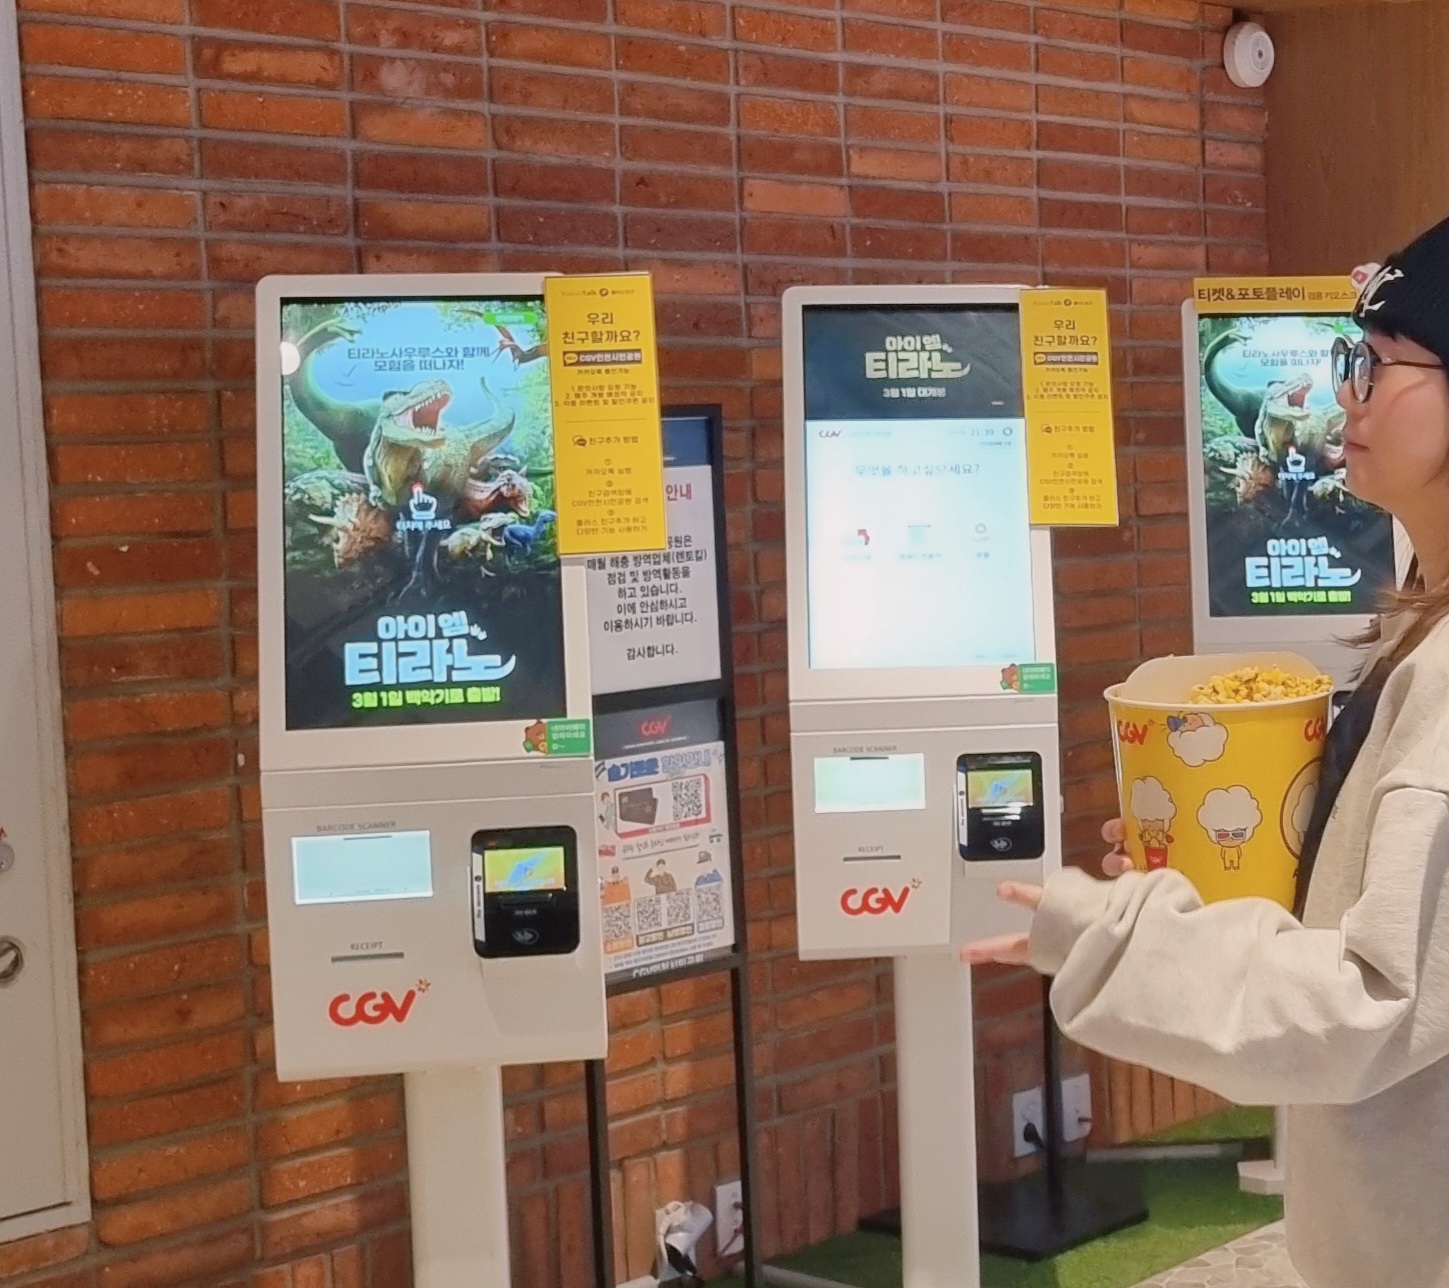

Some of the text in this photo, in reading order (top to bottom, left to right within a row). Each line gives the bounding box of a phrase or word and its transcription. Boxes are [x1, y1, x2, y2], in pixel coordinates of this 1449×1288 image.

[1198, 286, 1306, 303] 티켓&포토플레이
[586, 312, 614, 326] 우리
[1053, 319, 1077, 331] 우리
[562, 329, 641, 345] 친구할까요?
[885, 334, 921, 351] 아이
[1033, 334, 1098, 347] 친구할까요?
[347, 345, 491, 360] 티라노사우루스와 함께
[373, 358, 465, 372] 모험을 떠나자!
[865, 350, 972, 379] 티라노
[666, 484, 693, 501] 안내
[1266, 538, 1306, 556] 아이
[586, 558, 607, 571] 매월
[1245, 555, 1362, 588] 티라노
[607, 566, 691, 586] 점검 및 방역활동을
[617, 582, 683, 599] 하고 있습니다.
[616, 597, 688, 616] 이에 안심하시고
[377, 610, 470, 639] 아이 엠
[603, 611, 698, 633] 이용하시기 바랍니다.
[626, 642, 679, 661] 감사합니다.
[344, 638, 517, 686] 티라노
[352, 690, 378, 708] 3월
[379, 689, 403, 706] 1일
[641, 718, 669, 736] CGV
[1117, 718, 1149, 746] CGV
[316, 821, 396, 832] BARCODE SCANNER
[840, 885, 911, 916] CGV
[350, 941, 383, 951] RECEIPT
[328, 988, 417, 1028] CGV
